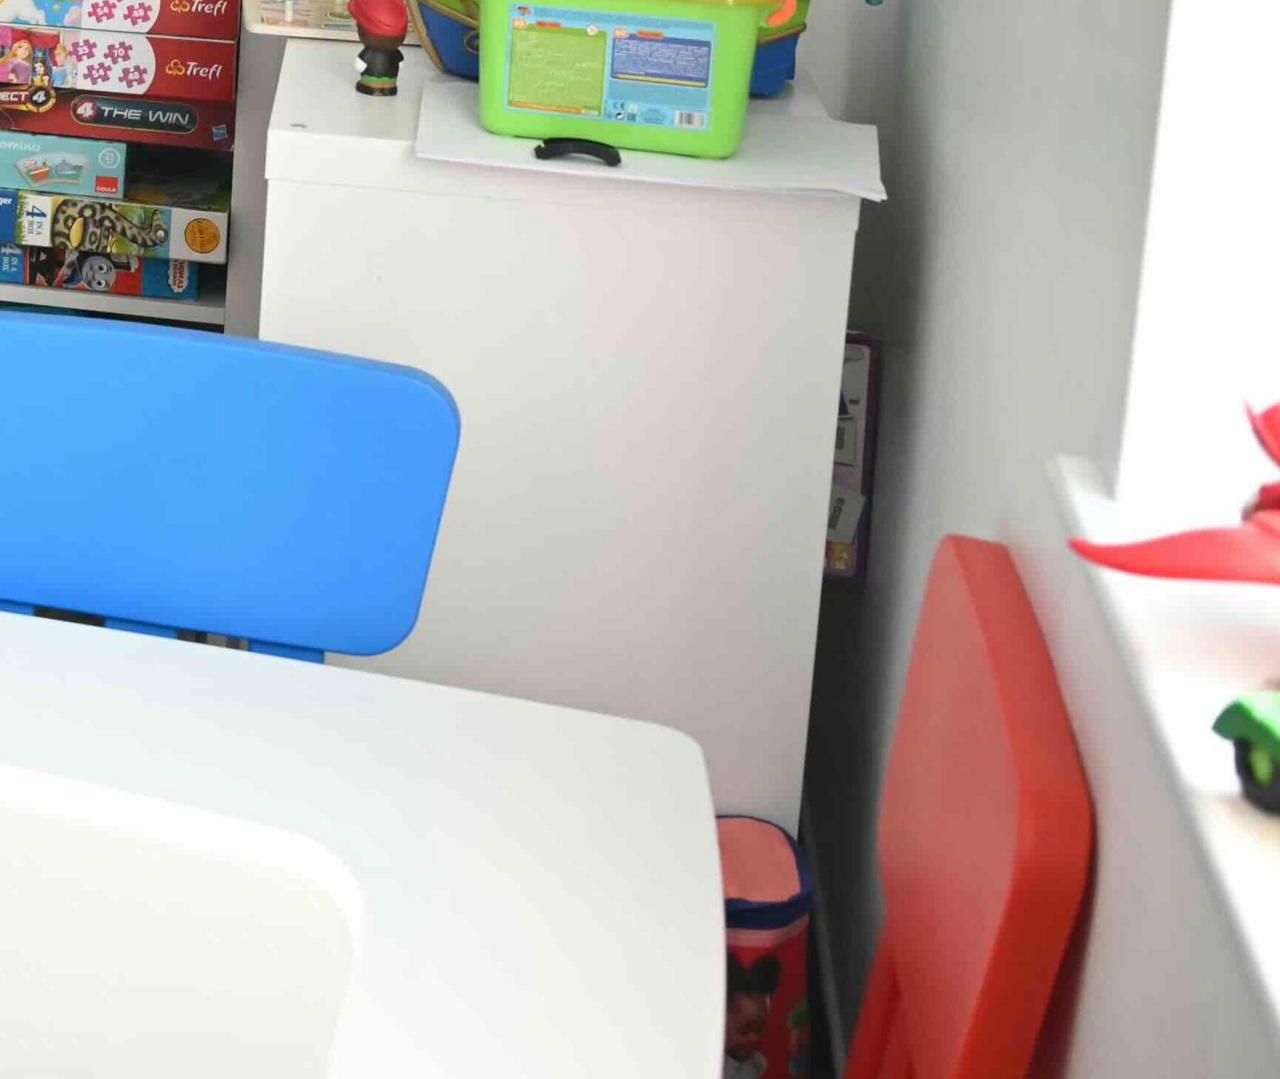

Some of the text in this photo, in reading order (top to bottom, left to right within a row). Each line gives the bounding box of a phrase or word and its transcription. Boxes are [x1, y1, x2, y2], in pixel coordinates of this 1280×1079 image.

[112, 48, 125, 57] 70
[186, 61, 223, 80] Trefl
[31, 89, 47, 103] 4
[76, 102, 190, 126] 4 THE WIN
[26, 205, 48, 218] 4
